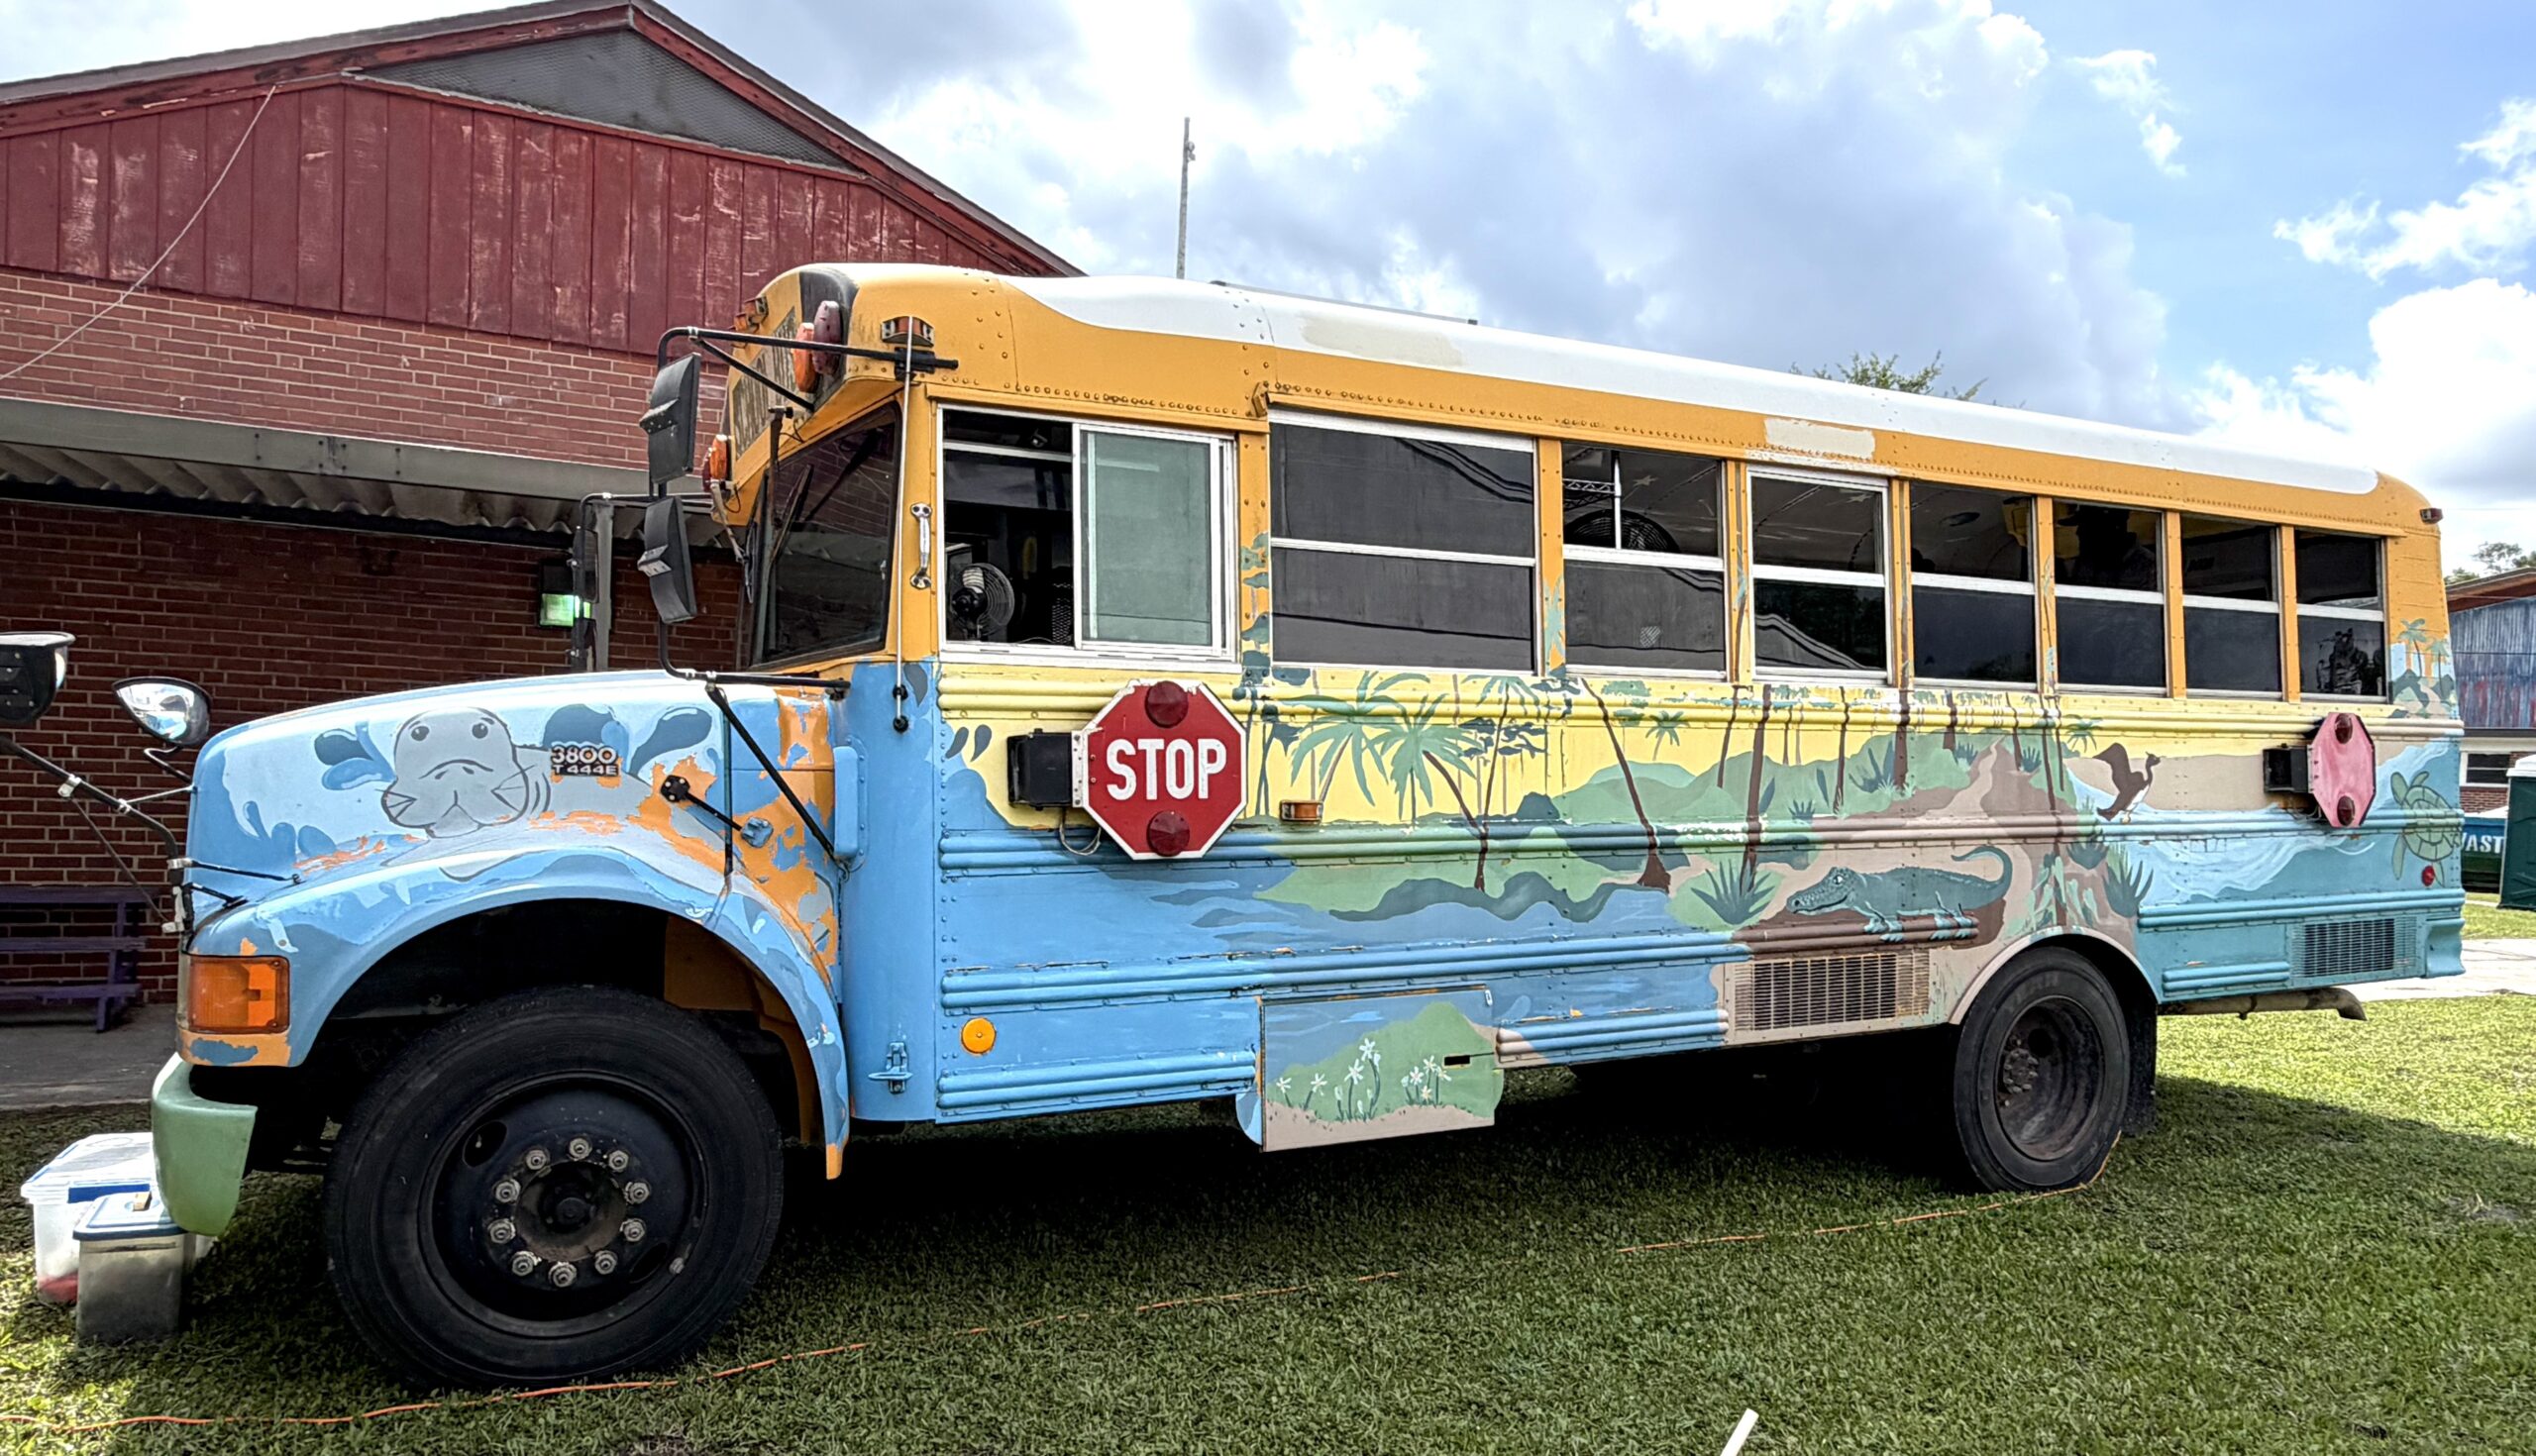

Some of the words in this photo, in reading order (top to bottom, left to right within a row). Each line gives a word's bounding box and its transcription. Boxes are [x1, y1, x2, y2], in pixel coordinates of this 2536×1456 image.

[551, 745, 617, 765] 3800
[1106, 738, 1227, 801] STOP
[2462, 832, 2504, 854] AST
